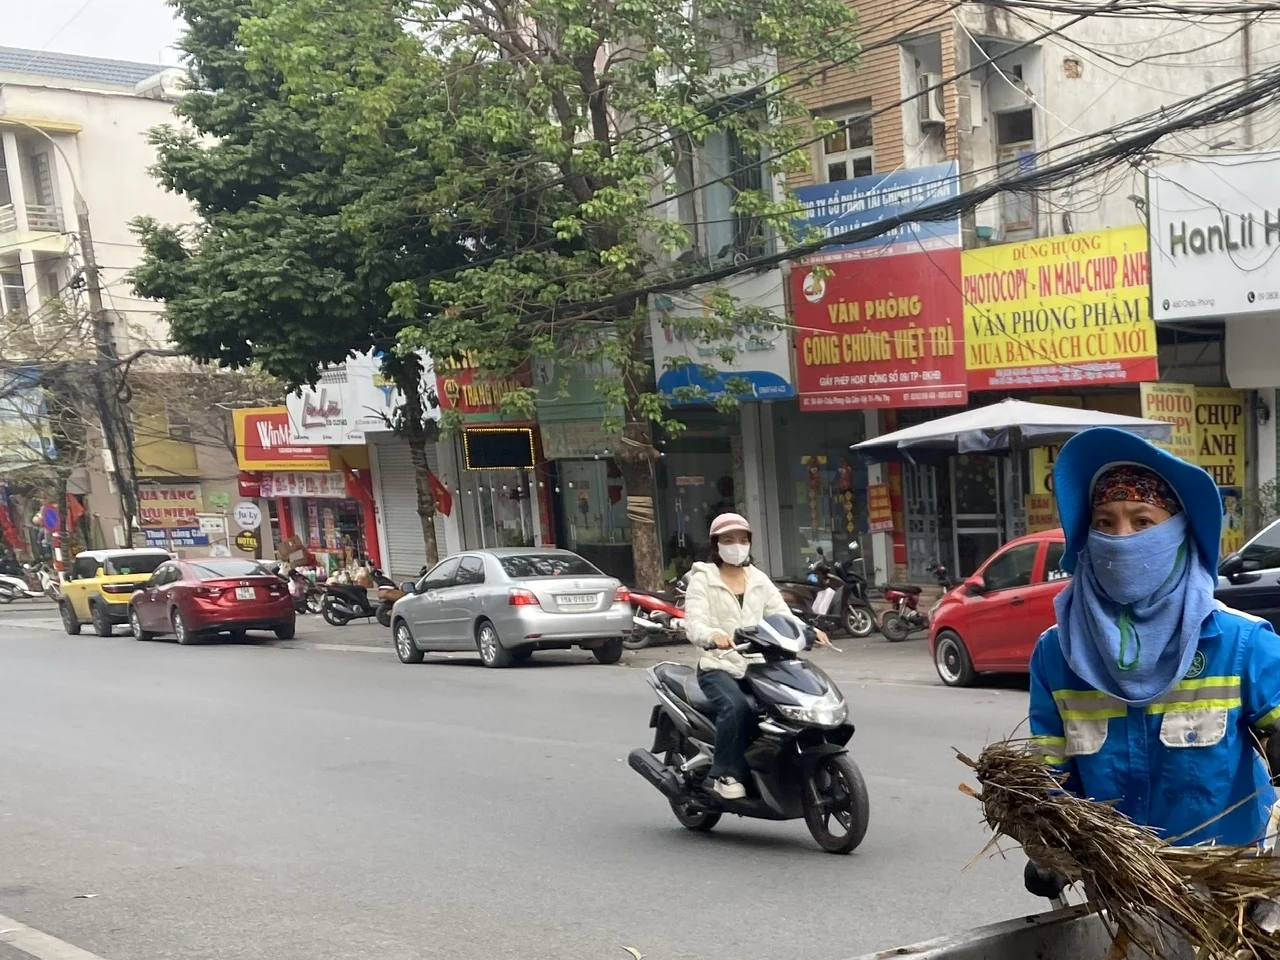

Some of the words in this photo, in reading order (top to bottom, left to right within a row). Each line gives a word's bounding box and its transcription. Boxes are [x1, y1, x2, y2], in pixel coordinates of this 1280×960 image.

[1013, 243, 1048, 261] DŨNG
[964, 268, 1028, 305] PHOTOCOPY
[1039, 263, 1051, 297] IN
[828, 298, 860, 323] VĂN
[865, 292, 922, 320] PHÒNG
[972, 308, 1006, 336] VĂN
[1012, 301, 1076, 334] PHÒNG
[803, 331, 840, 365] CÔNG
[842, 326, 891, 363] CHỨNG
[894, 321, 925, 365] VIỆT
[929, 317, 955, 356] TRÌ
[970, 342, 1003, 366] MUA
[1006, 333, 1036, 362] BÁN
[1039, 329, 1081, 359] SÁCH
[1086, 327, 1108, 357] CŨ
[1113, 322, 1149, 355] MỚI
[1146, 393, 1192, 413] PHOTO
[1195, 403, 1242, 431] CHỤP
[1200, 428, 1237, 456] ẢNH
[237, 537, 258, 547] HOTEL
